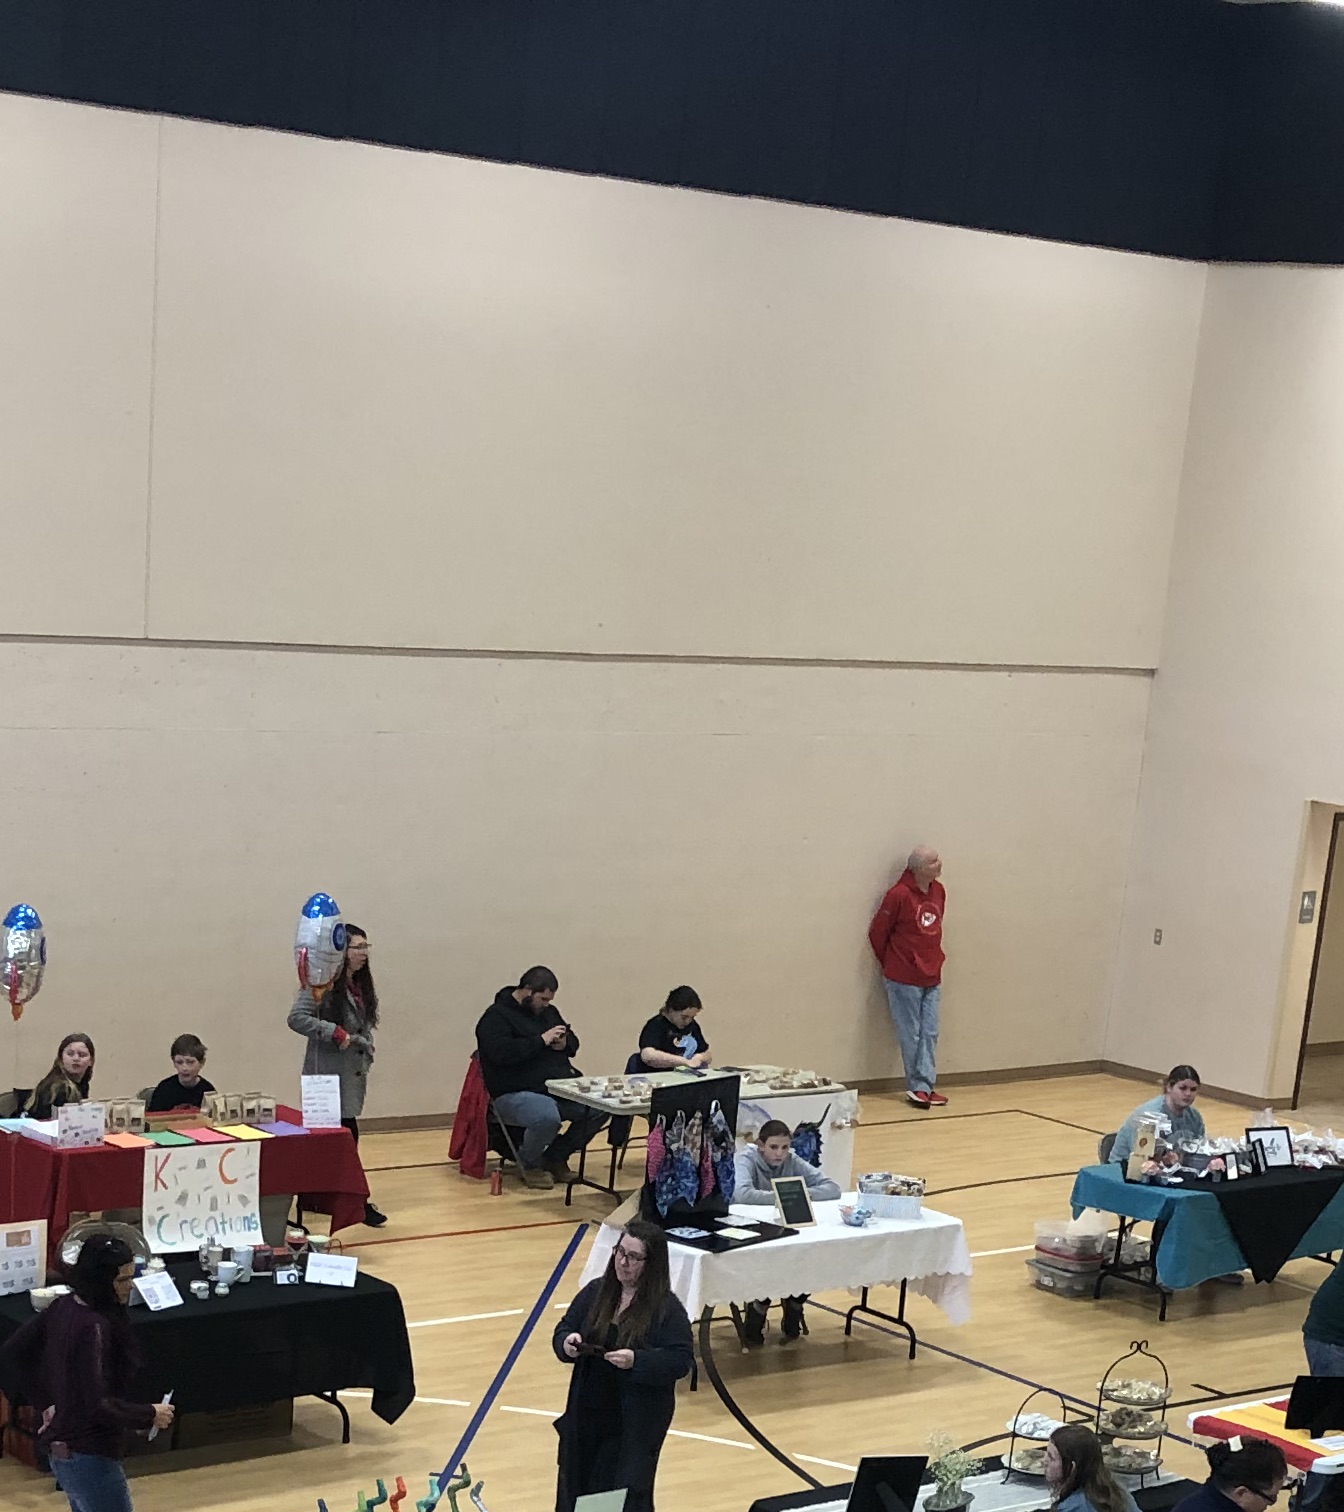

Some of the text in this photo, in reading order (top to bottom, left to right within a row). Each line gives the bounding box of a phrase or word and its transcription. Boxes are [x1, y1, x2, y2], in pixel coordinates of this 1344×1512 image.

[154, 1147, 238, 1193] K C
[157, 1212, 259, 1246] Creations
